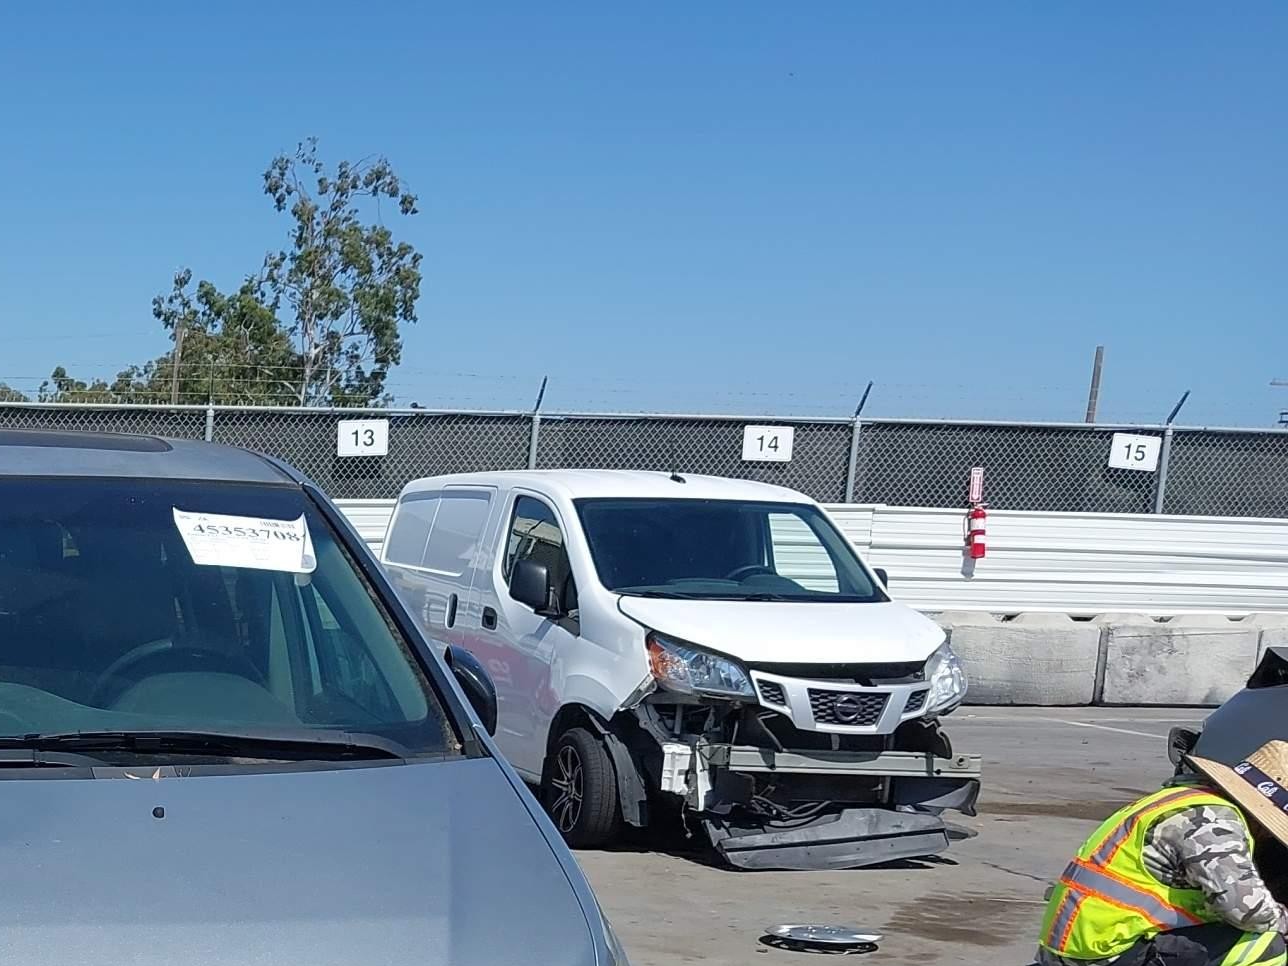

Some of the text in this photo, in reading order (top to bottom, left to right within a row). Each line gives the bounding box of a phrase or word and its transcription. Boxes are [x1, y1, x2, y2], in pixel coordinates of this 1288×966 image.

[351, 429, 375, 447] 13
[756, 435, 779, 453] 14
[1124, 443, 1147, 462] 15
[193, 524, 300, 542] 45353708
